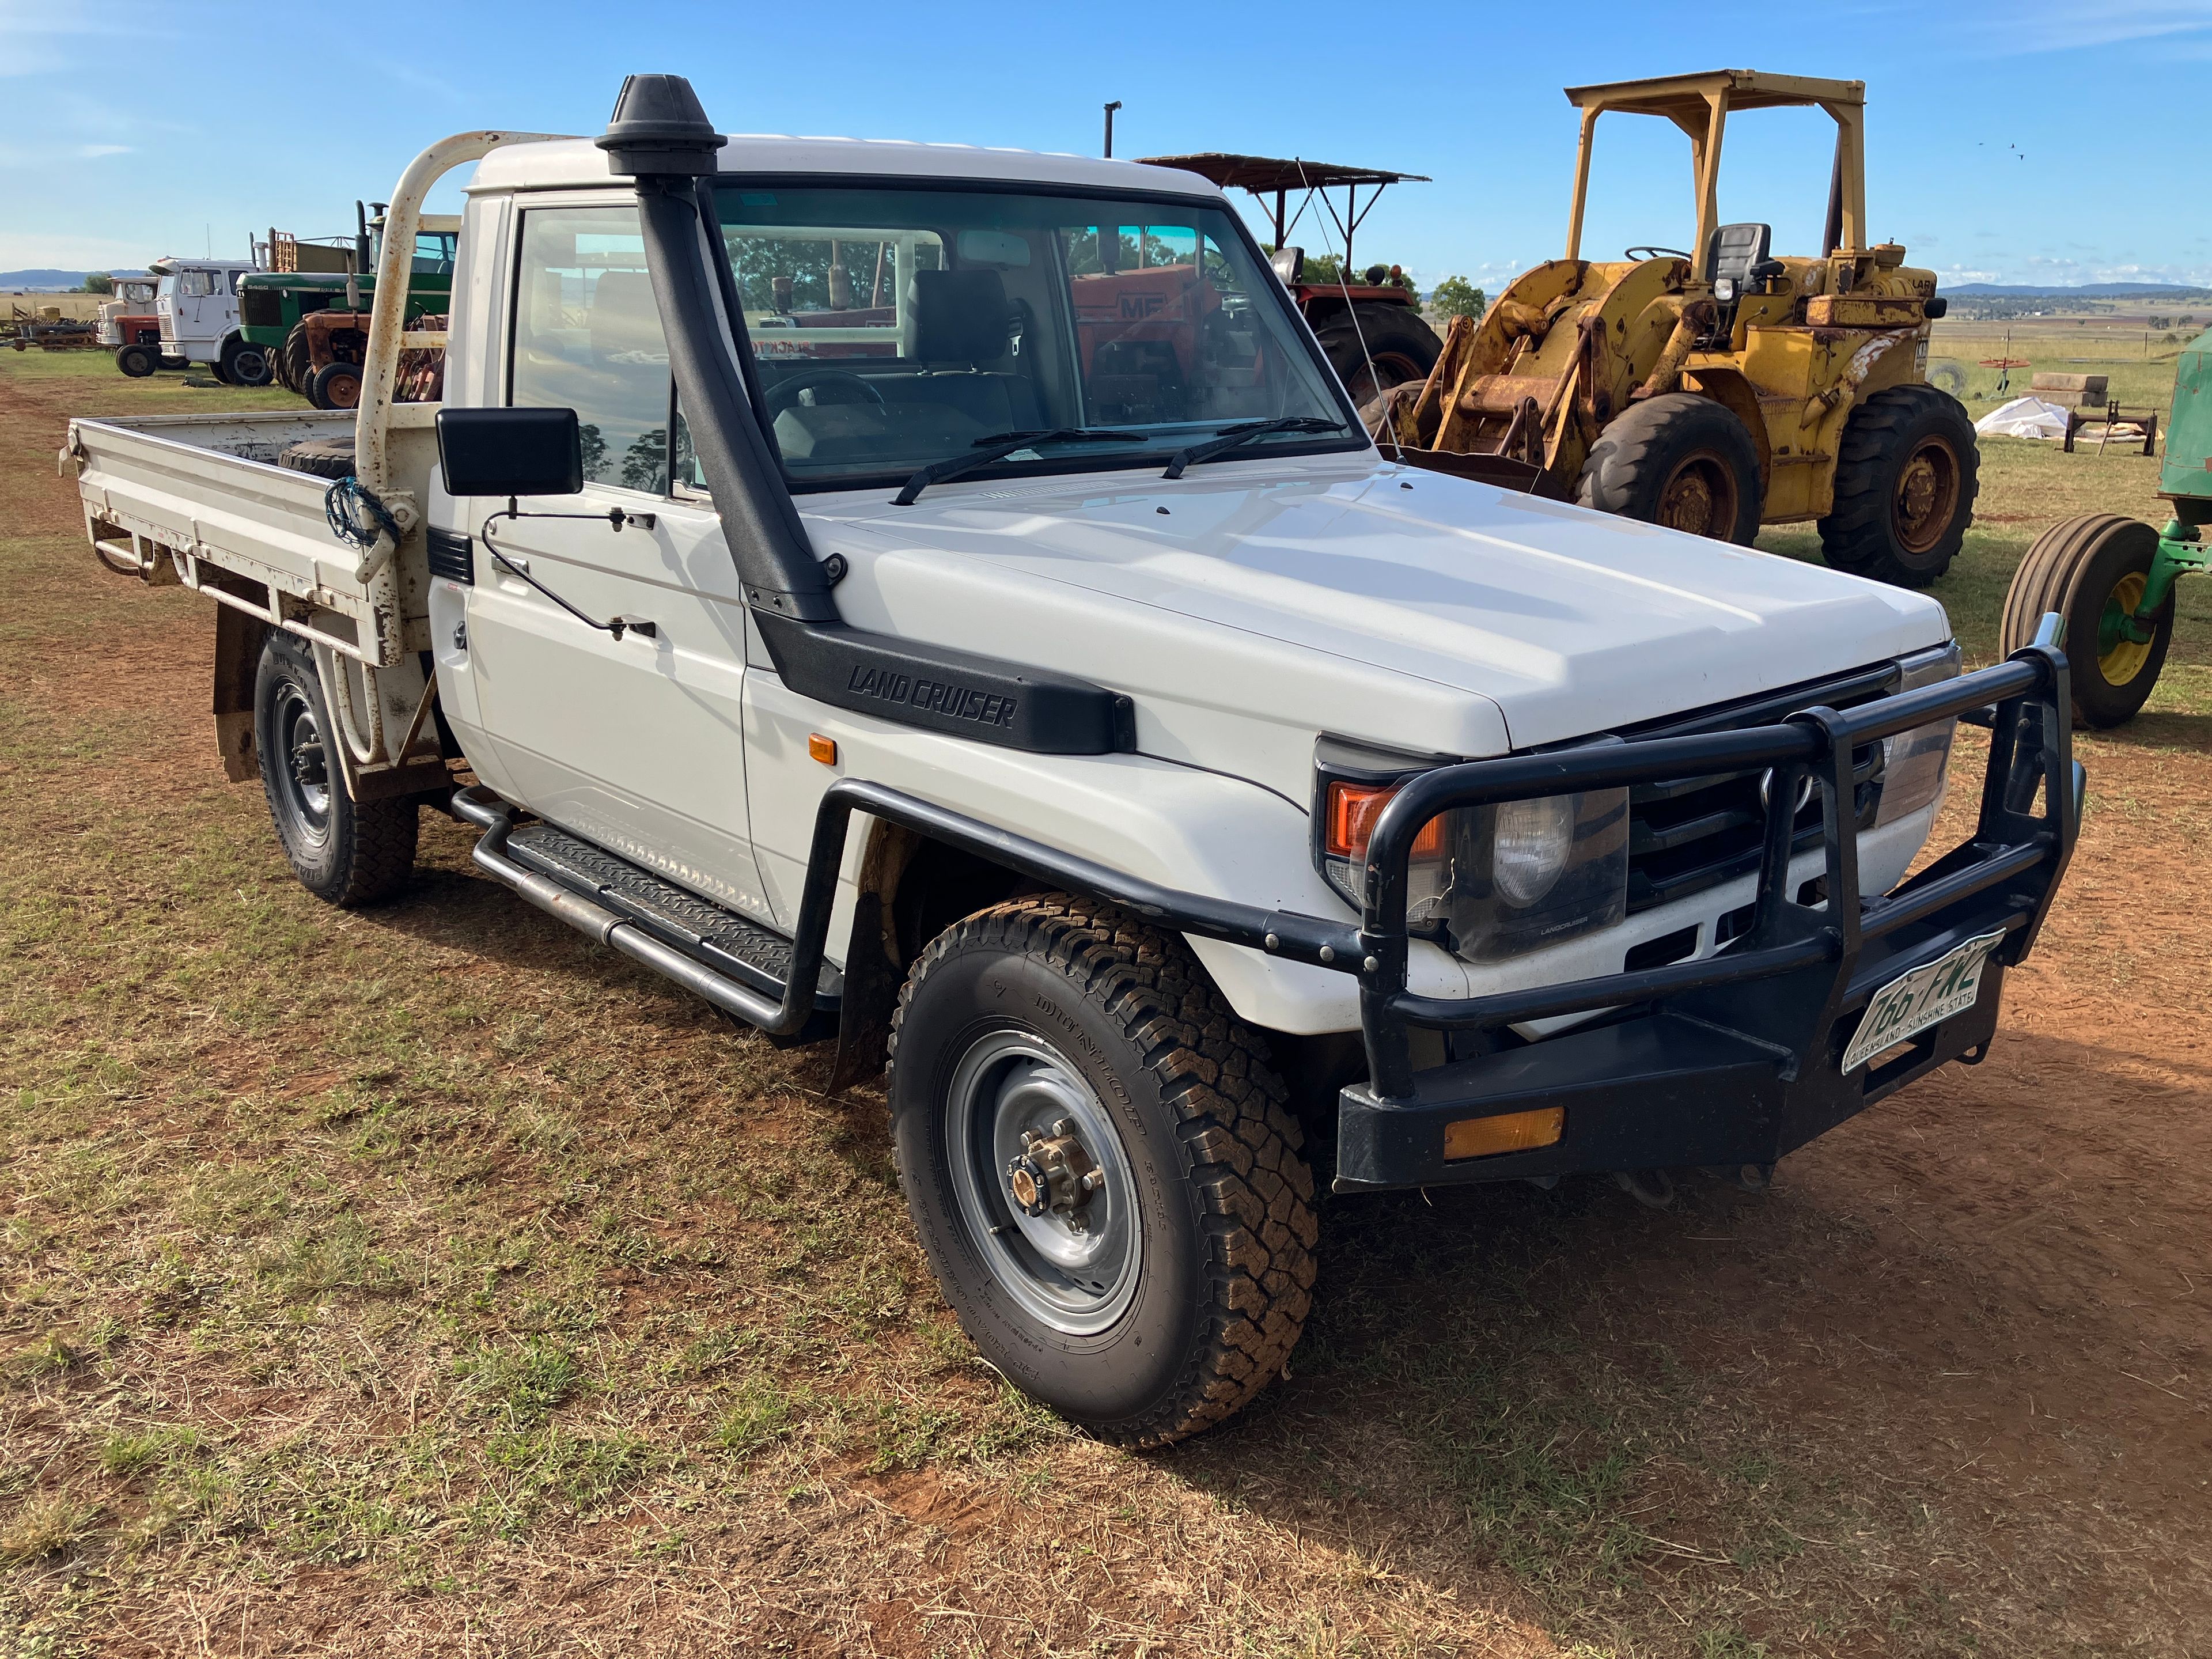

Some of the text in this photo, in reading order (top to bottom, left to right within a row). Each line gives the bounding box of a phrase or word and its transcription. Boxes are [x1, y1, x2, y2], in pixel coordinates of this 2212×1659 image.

[1121, 297, 1163, 318] MF
[1540, 916, 1588, 935] LANDCRUISER
[1850, 1027, 1900, 1065] QUEENSLAND
[1907, 1003, 1945, 1032] SUNSHINE
[1033, 991, 1146, 1135] DUNLOP
